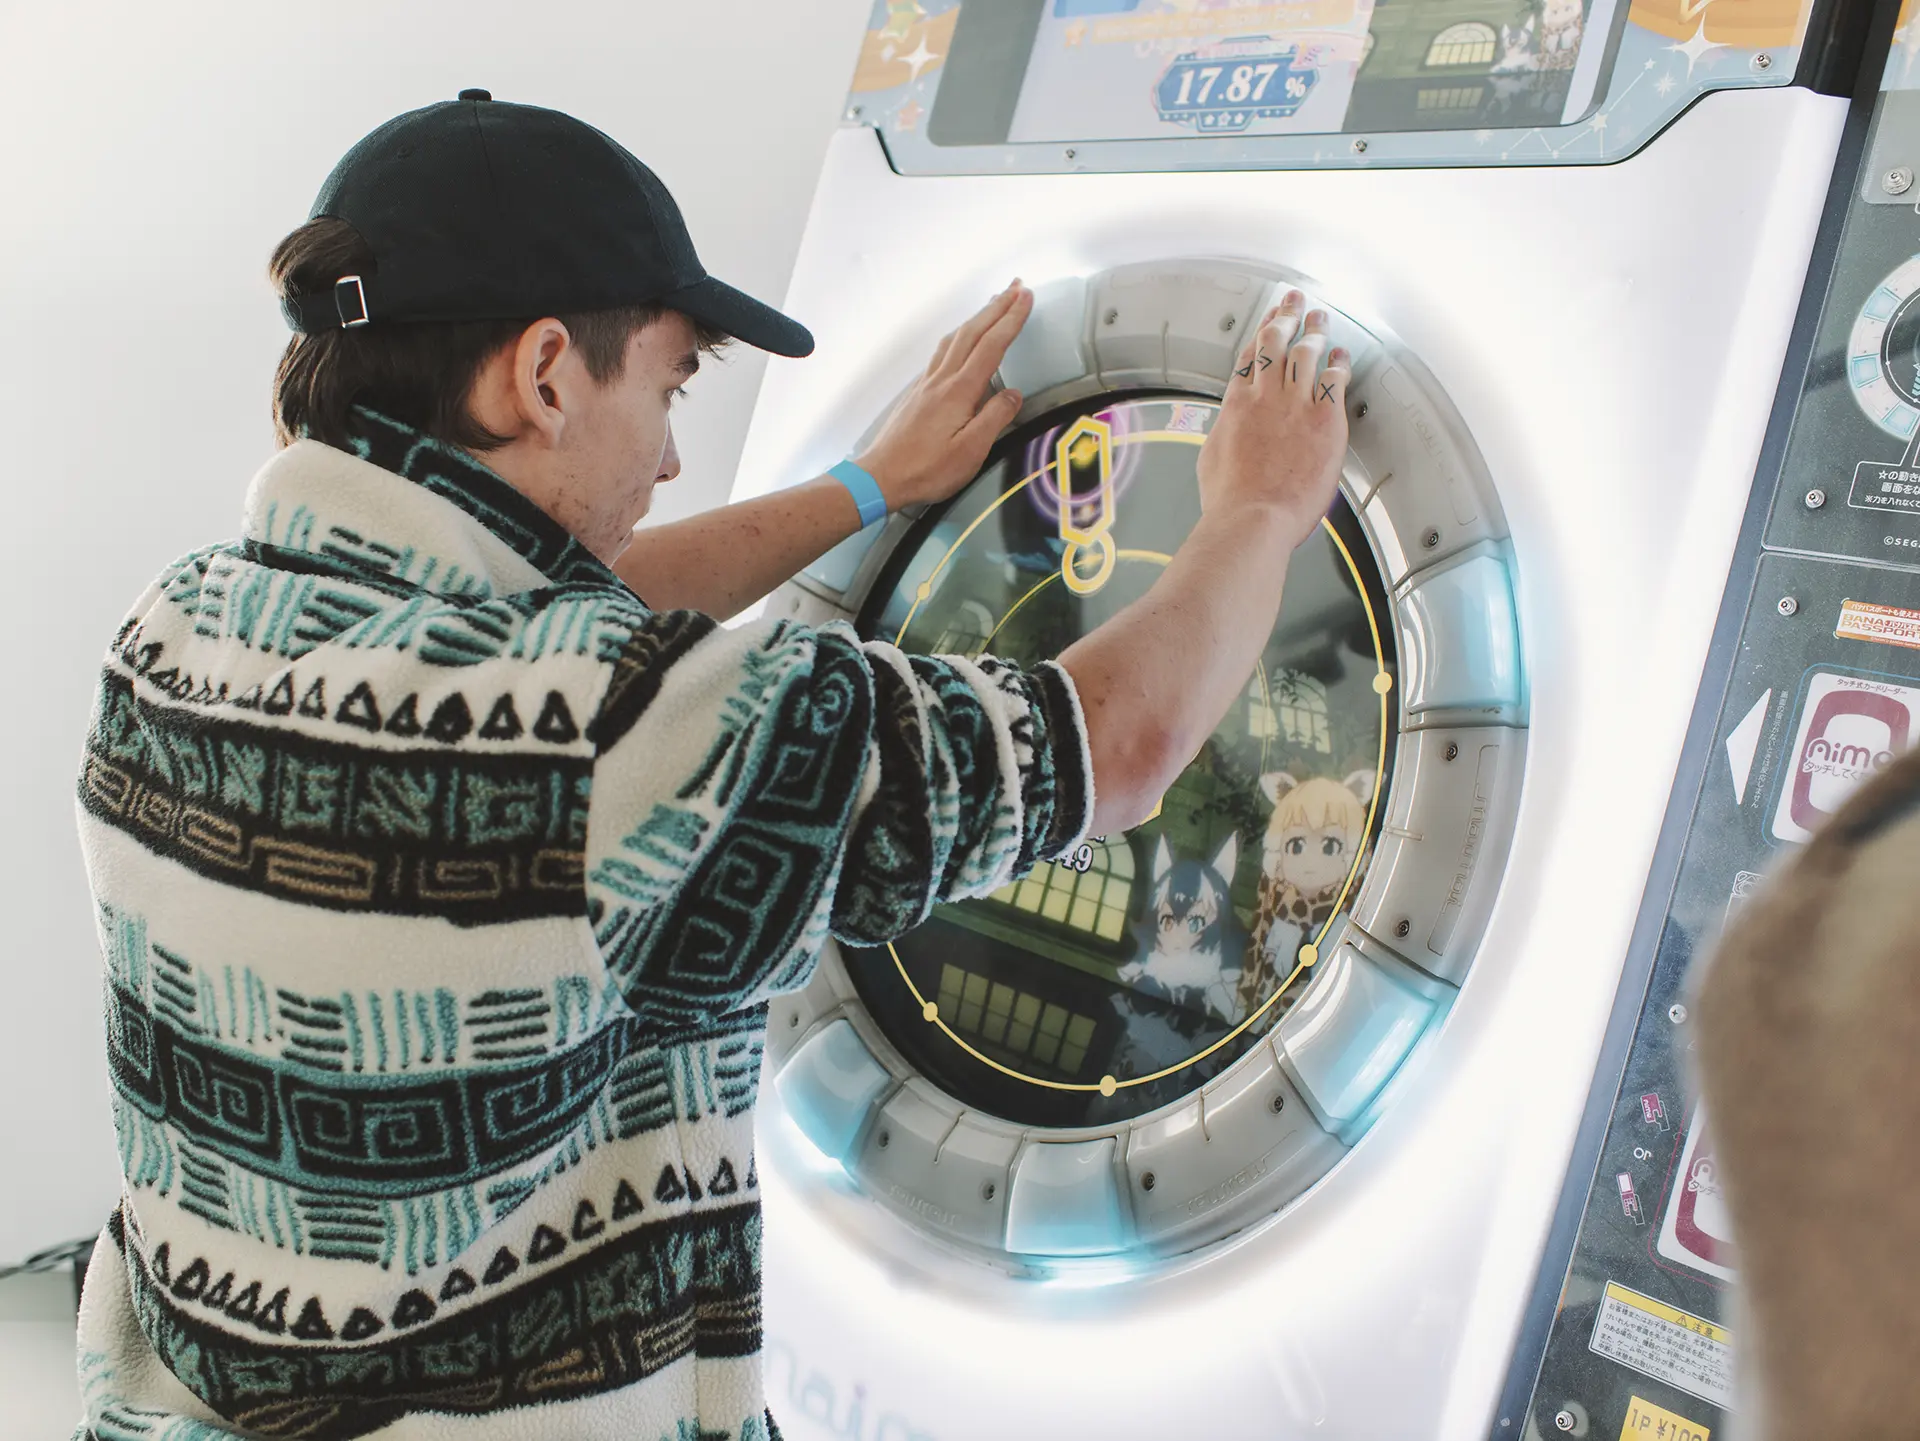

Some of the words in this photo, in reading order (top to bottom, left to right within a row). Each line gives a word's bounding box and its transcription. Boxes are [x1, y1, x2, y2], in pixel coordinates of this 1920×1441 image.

[1174, 64, 1279, 105] 17.87
[1285, 77, 1306, 99] %
[1884, 536, 1920, 548] ©SEG
[1837, 679, 1907, 695] タッチ式カードリーダー
[1692, 1323, 1714, 1339] 注意
